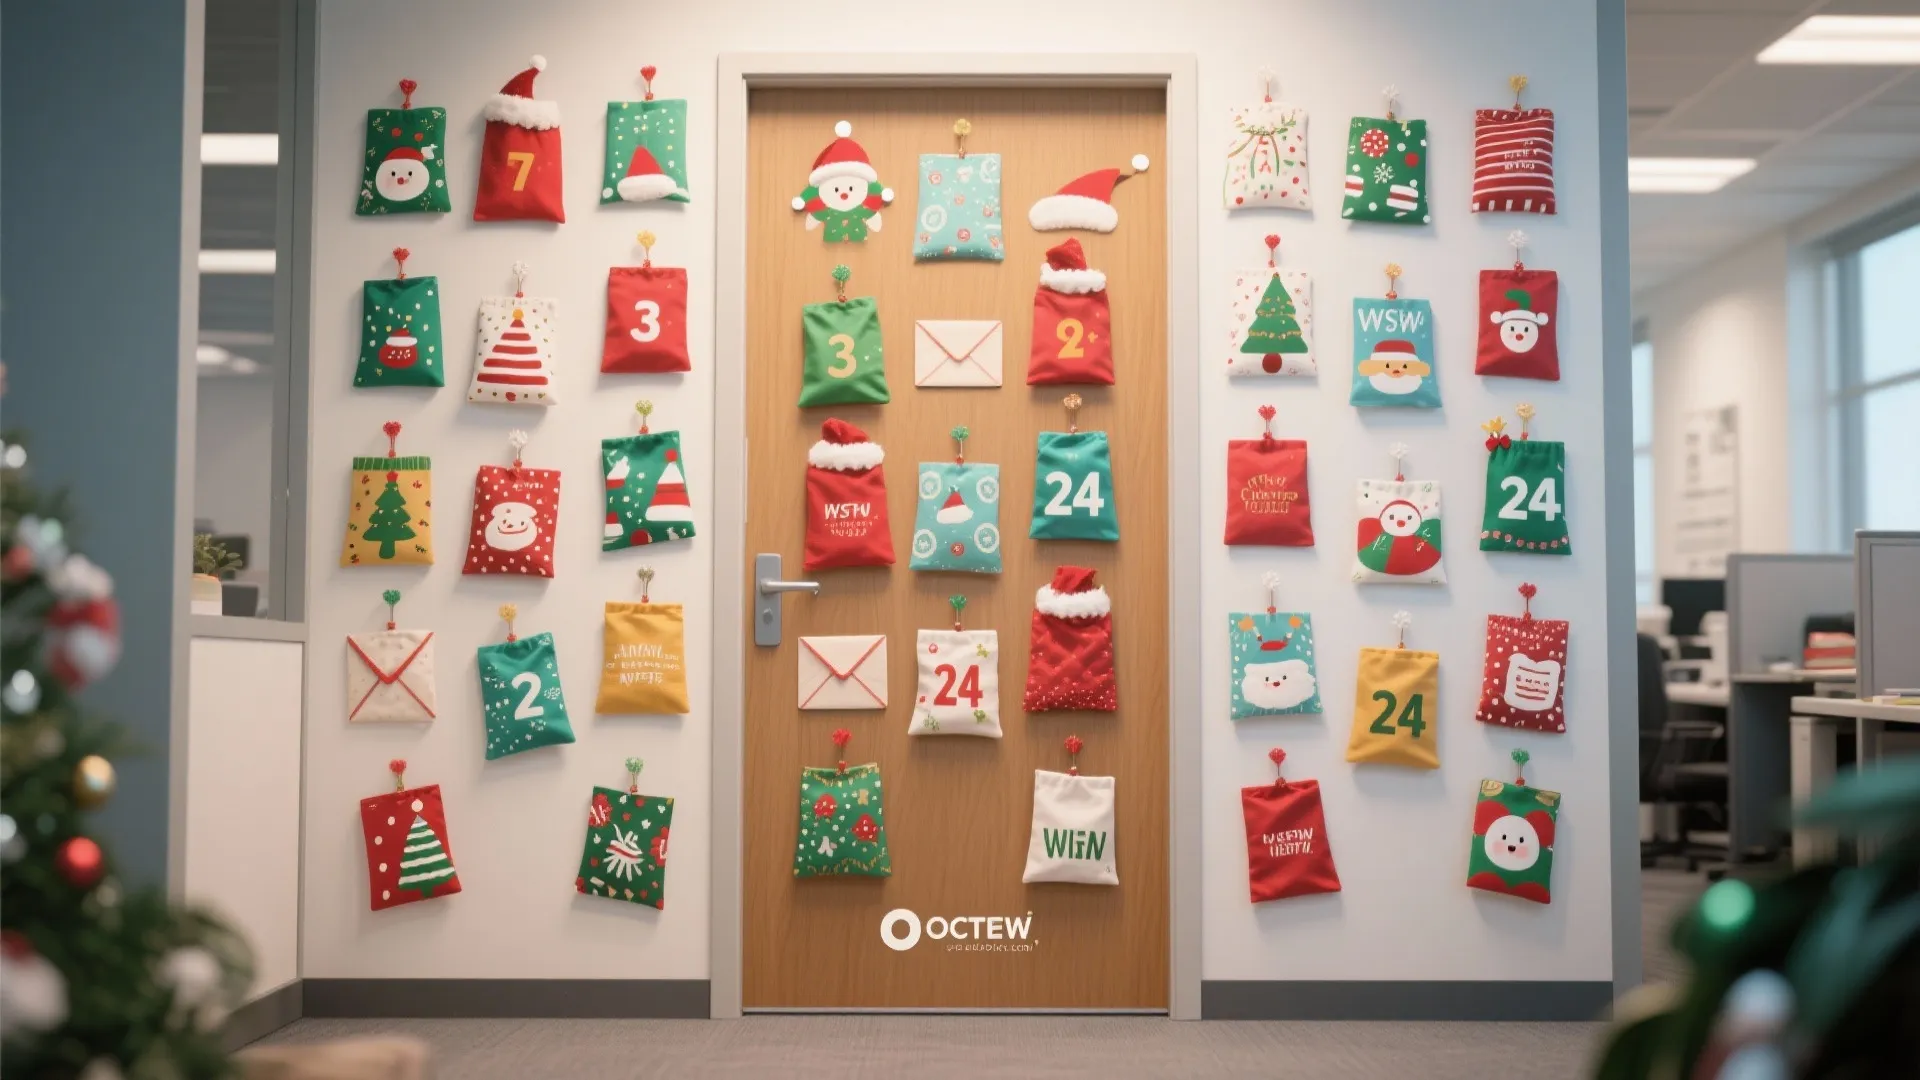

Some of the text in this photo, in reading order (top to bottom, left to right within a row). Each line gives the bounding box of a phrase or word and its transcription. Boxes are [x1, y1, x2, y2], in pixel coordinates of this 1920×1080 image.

[508, 153, 534, 191] 7
[630, 300, 661, 343] 3
[1056, 317, 1084, 360] 2
[827, 333, 857, 379] 3
[1044, 471, 1104, 516] 24
[1499, 477, 1561, 521] 24
[511, 672, 544, 720] 2
[933, 664, 983, 708] 24
[1370, 689, 1427, 738] 24
